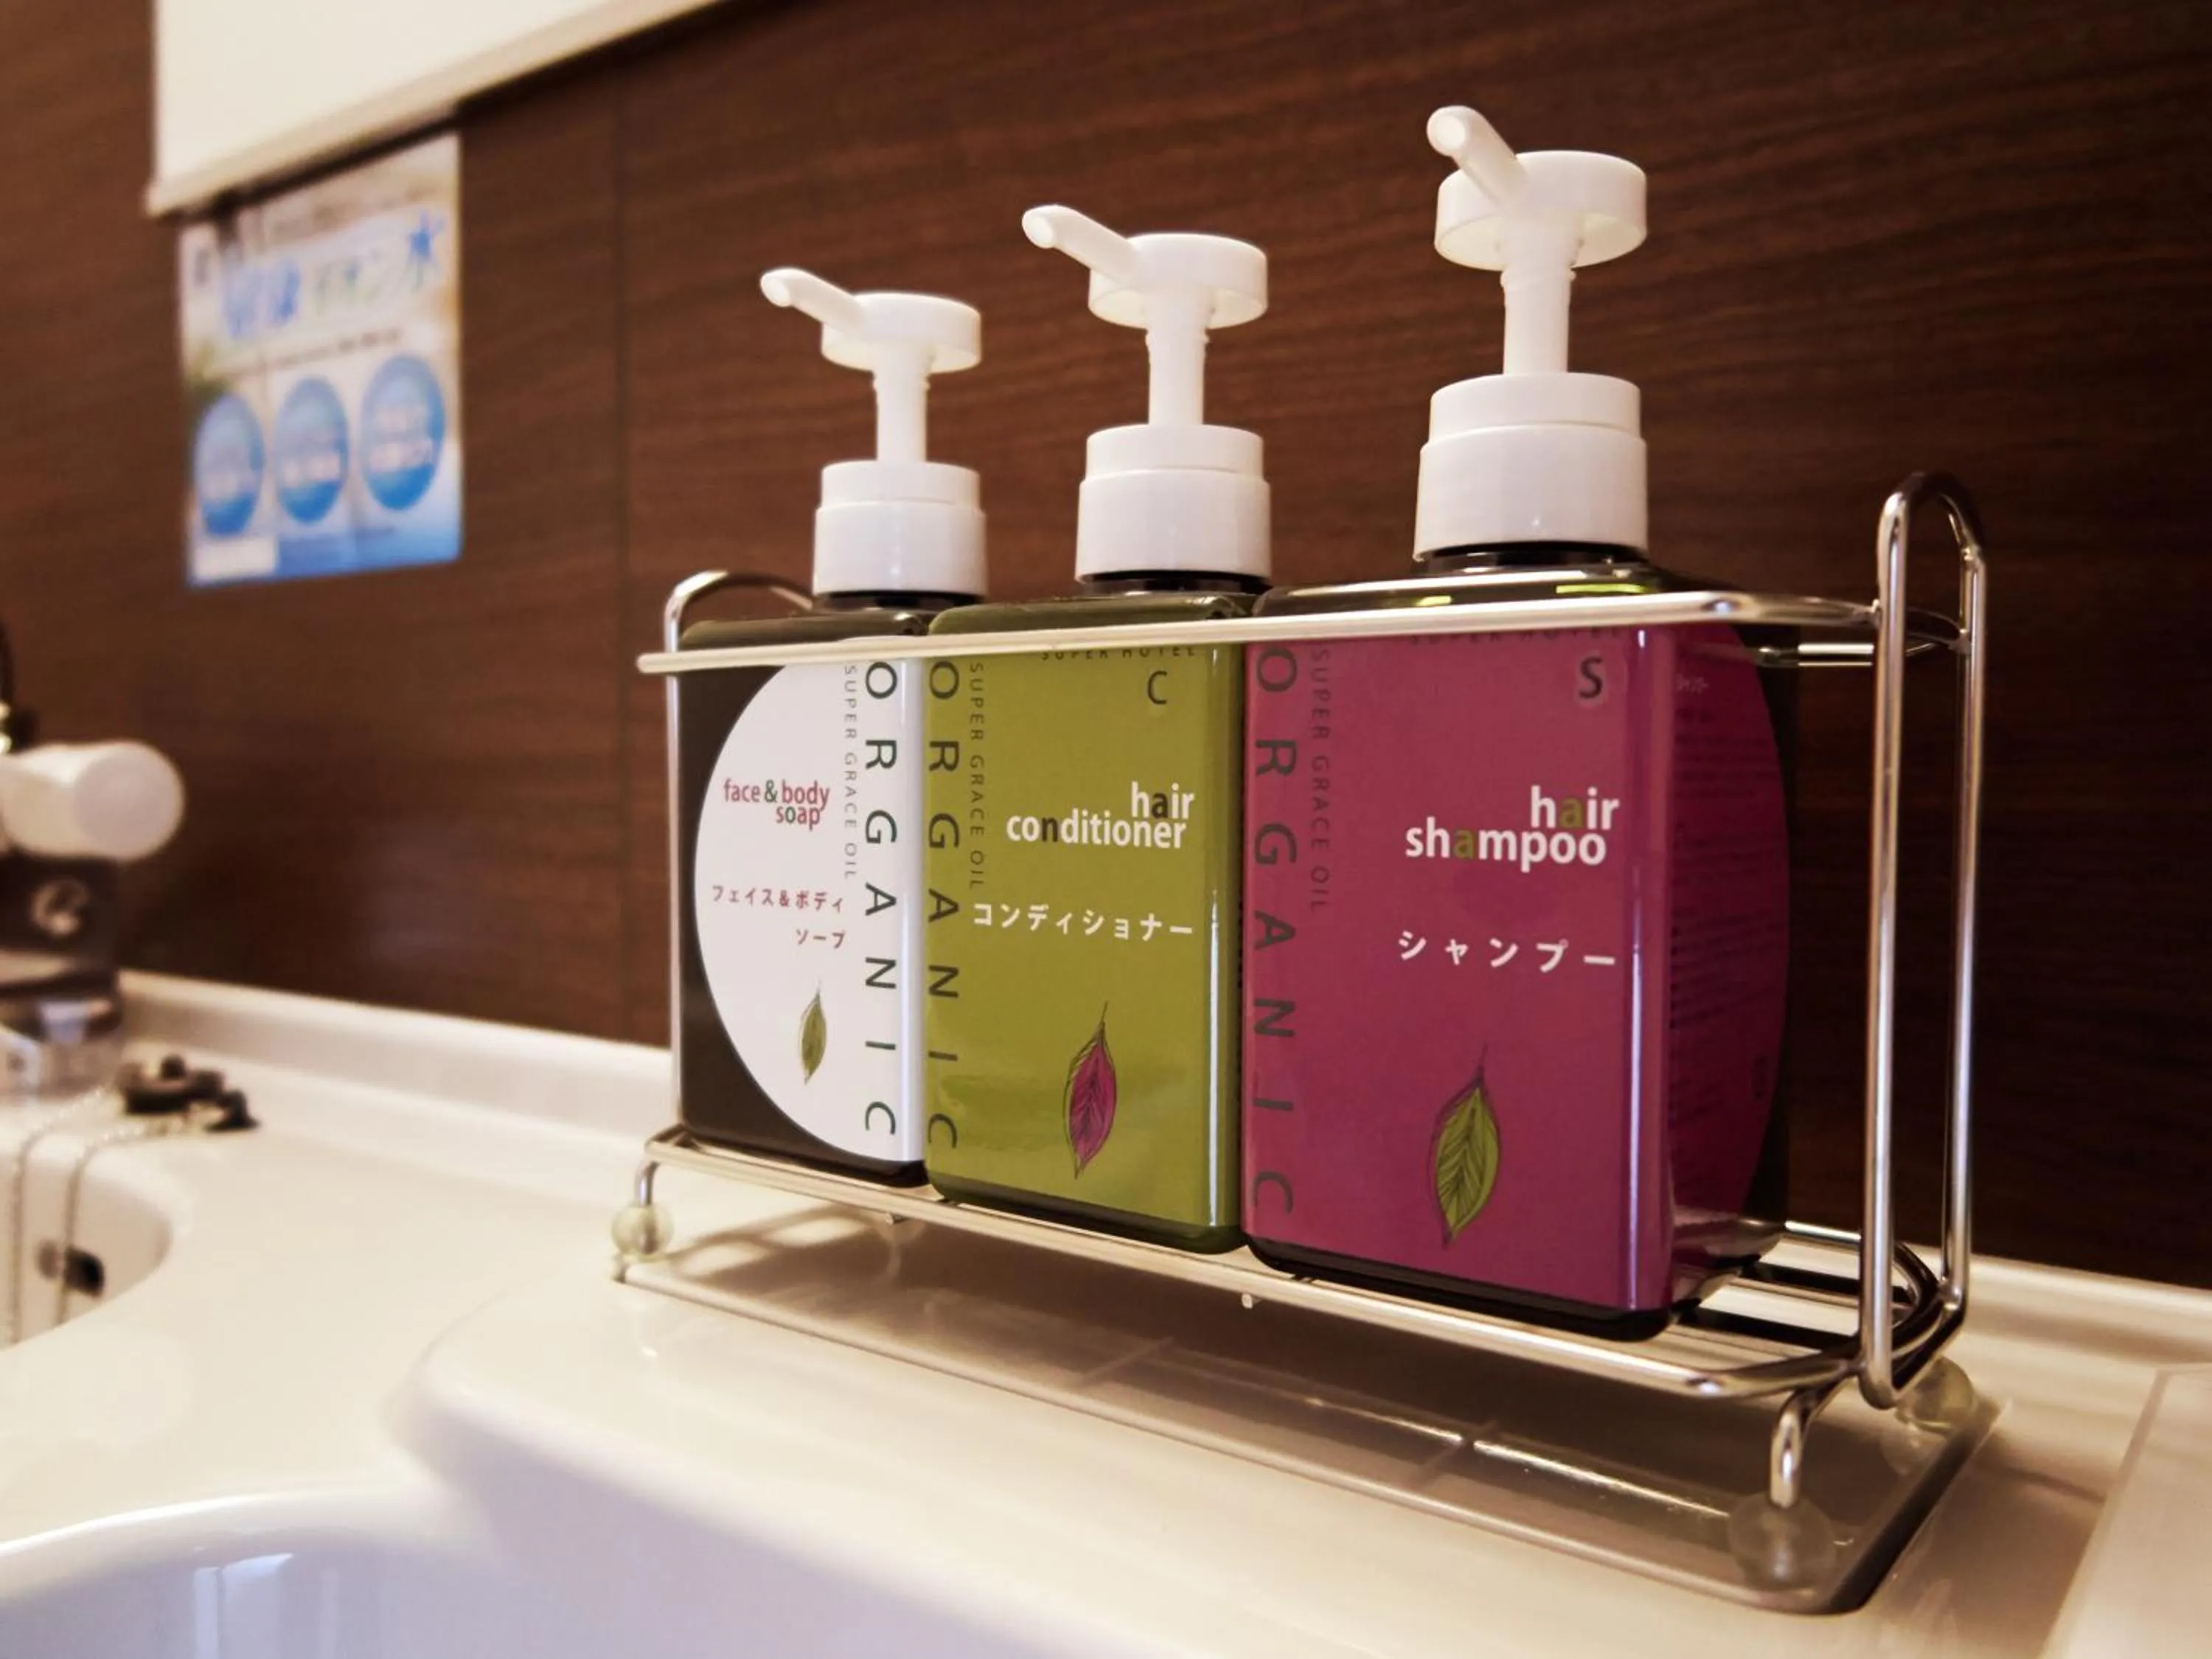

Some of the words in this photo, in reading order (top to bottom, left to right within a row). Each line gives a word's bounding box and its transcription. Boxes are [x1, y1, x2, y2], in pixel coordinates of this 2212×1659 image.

[1147, 669, 1168, 705] C
[1311, 648, 1331, 740] SUPER
[1579, 655, 1604, 699] S
[844, 664, 858, 739] SUPER
[970, 662, 984, 741] SUPER
[844, 751, 858, 828] GRACE
[970, 754, 984, 836] GRACE
[1130, 781, 1194, 819] hair
[1311, 754, 1330, 850] GRACE
[1530, 784, 1620, 830] hair
[776, 805, 821, 831] soap
[1006, 808, 1187, 849] conditioner
[844, 842, 858, 880] OIL
[1405, 816, 1607, 873] shampoo
[969, 849, 984, 890] OIL
[1310, 865, 1329, 913] OIL
[865, 661, 898, 1135] ORGANIC
[928, 660, 959, 1149] ORGANIC
[796, 928, 846, 950] ソープ
[973, 902, 1194, 942] コンディショナー
[1252, 646, 1298, 1214] ORGANIC
[1398, 930, 1616, 973] シャンプー
